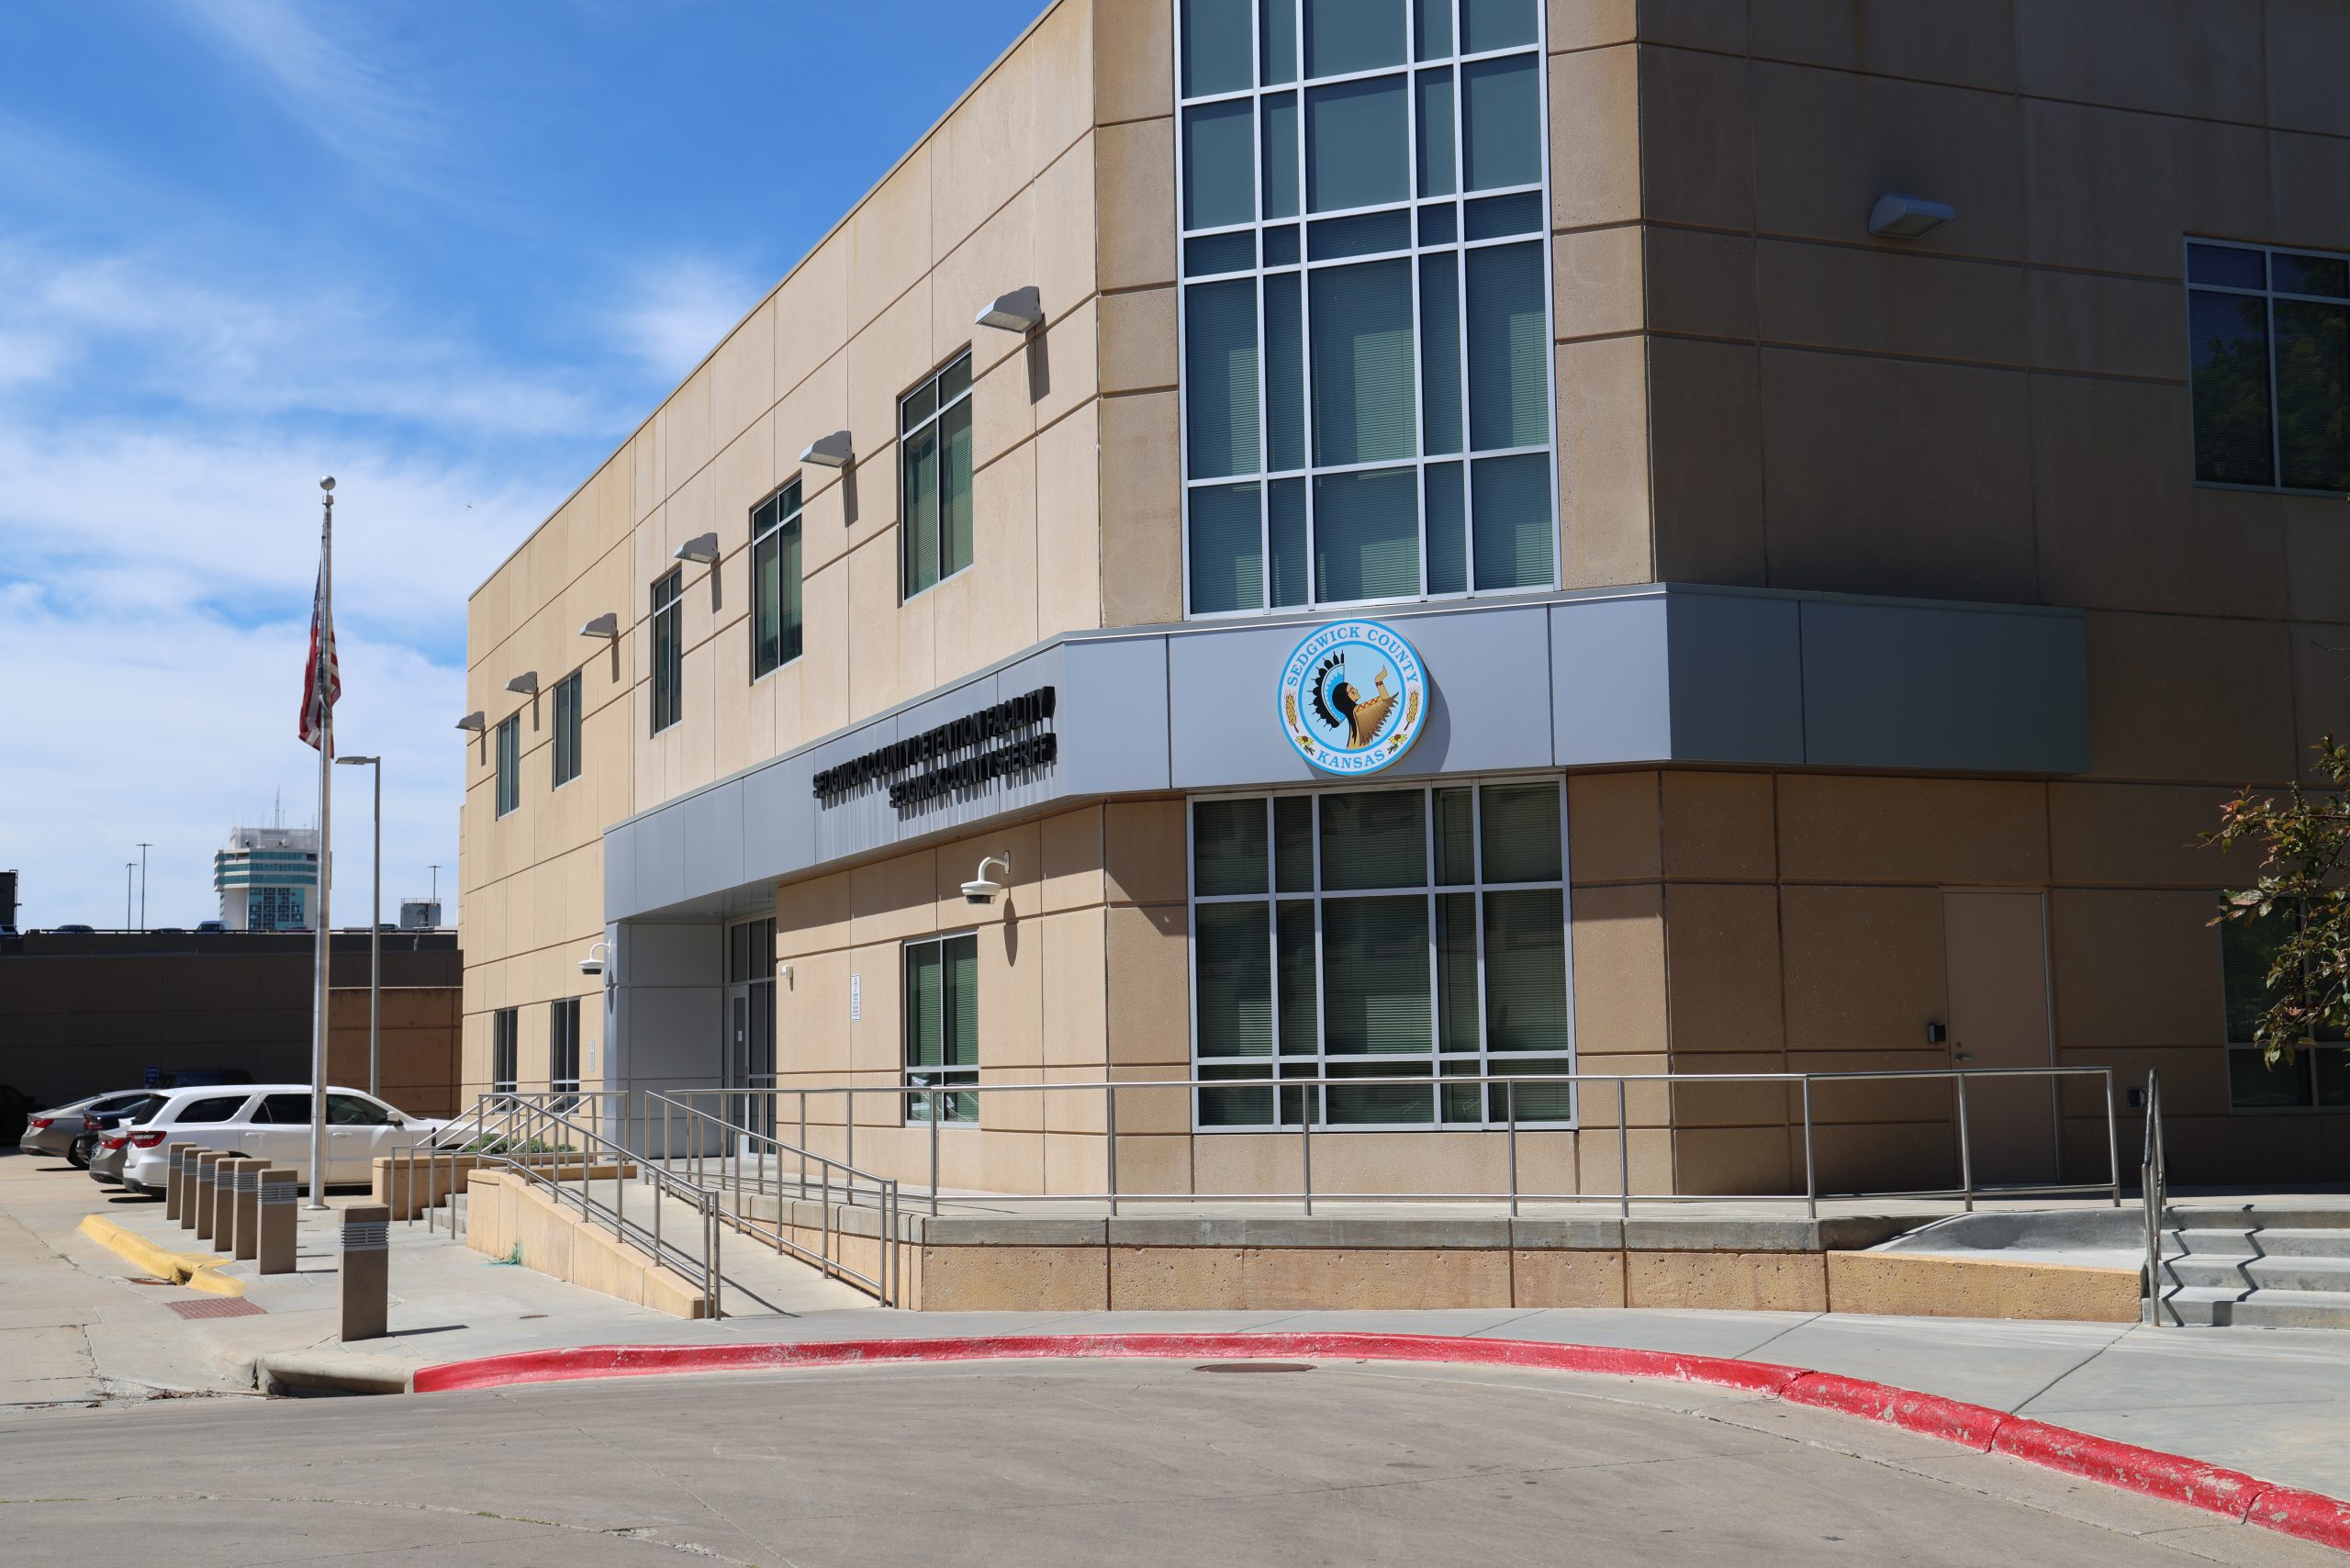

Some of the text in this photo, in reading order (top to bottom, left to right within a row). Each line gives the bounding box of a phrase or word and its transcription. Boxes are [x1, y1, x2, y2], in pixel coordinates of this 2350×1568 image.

[1287, 626, 1418, 687] SEDGWICK COUNTY
[812, 686, 1056, 799] SEDGWICK COUNTY DETENTION FACILITY
[889, 733, 1057, 808] SEDGWICK COUNTY SHERIFF
[1317, 749, 1385, 769] KANSAS
